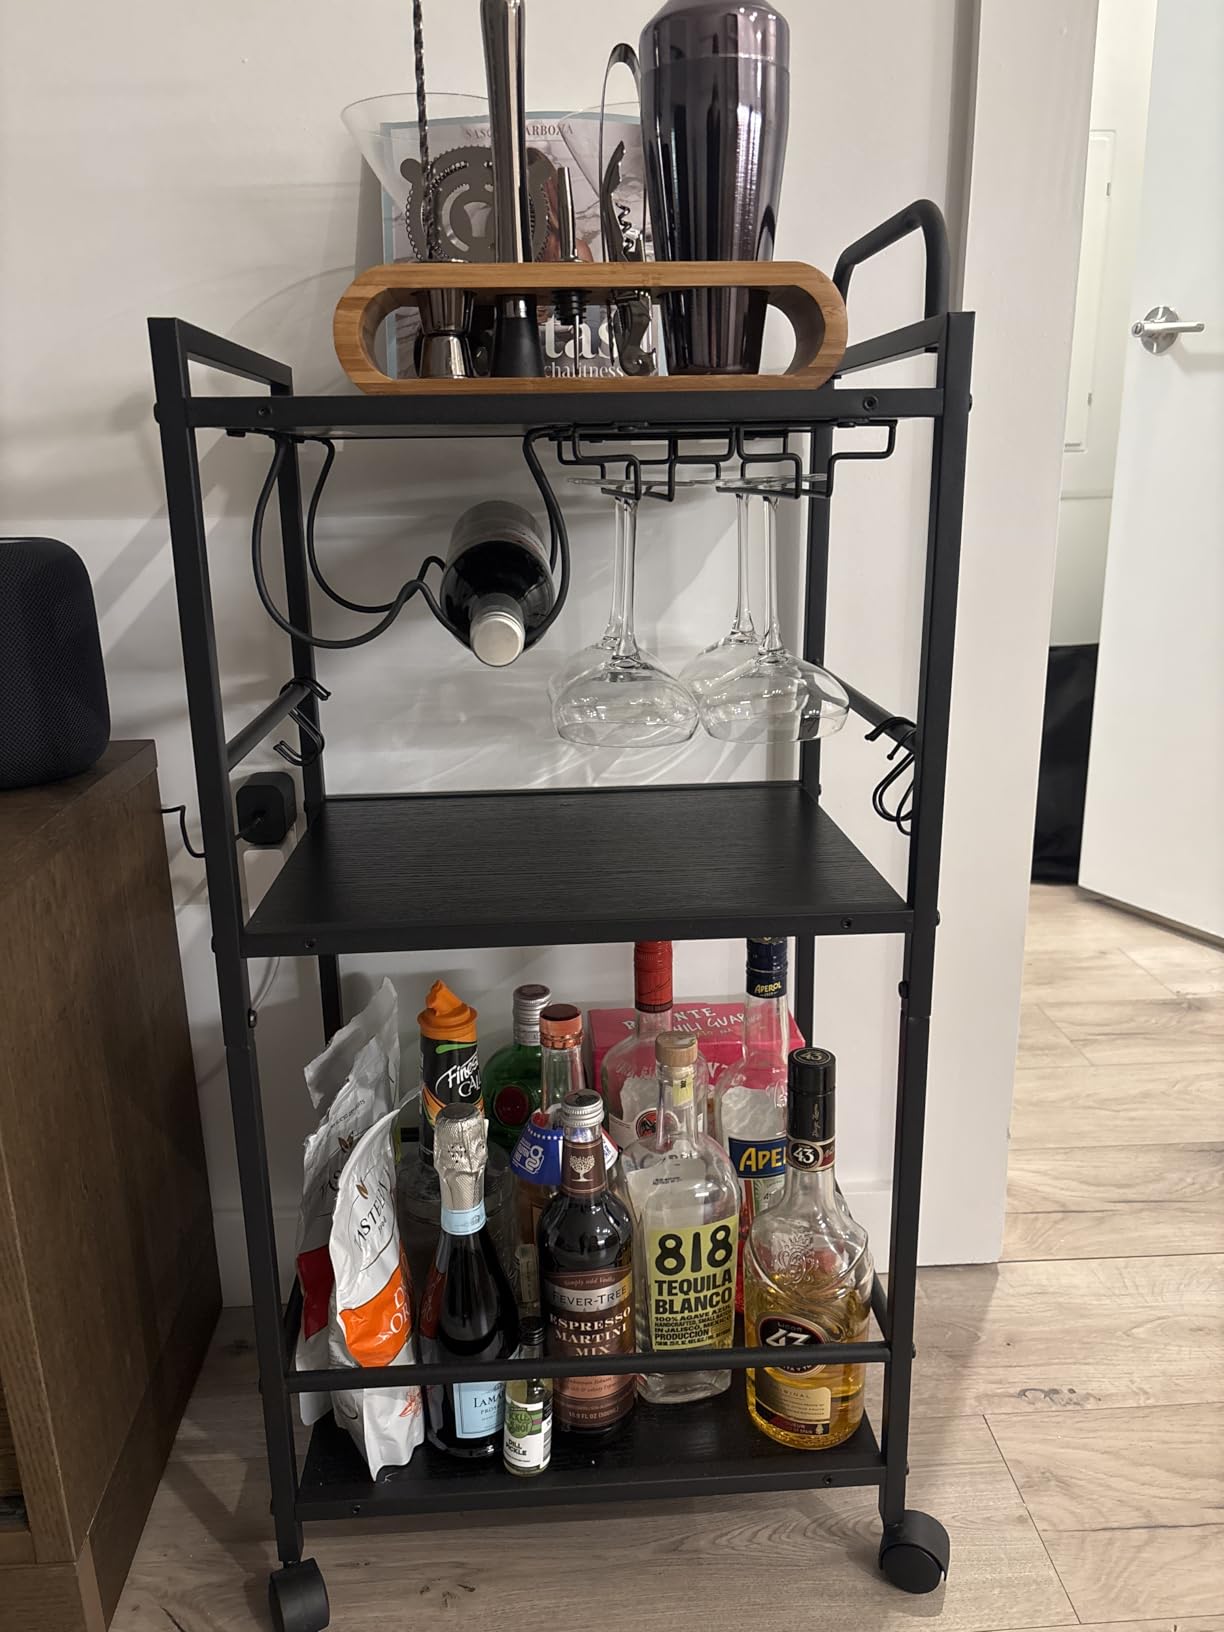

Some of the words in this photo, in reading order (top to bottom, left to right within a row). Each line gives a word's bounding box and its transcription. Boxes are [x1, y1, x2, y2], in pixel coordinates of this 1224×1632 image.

[754, 981, 782, 994] APEROL
[739, 1147, 786, 1172] APE
[793, 1147, 815, 1164] 43
[655, 1225, 733, 1276] 818
[655, 1268, 733, 1297] TEQUILA
[552, 1284, 628, 1307] FEVER-TREE
[655, 1286, 733, 1315] BLANCO
[549, 1306, 632, 1332] ESPRESSO
[680, 1311, 710, 1321] AGAVE
[556, 1322, 627, 1344] MARTINI
[575, 1344, 611, 1356] MIX
